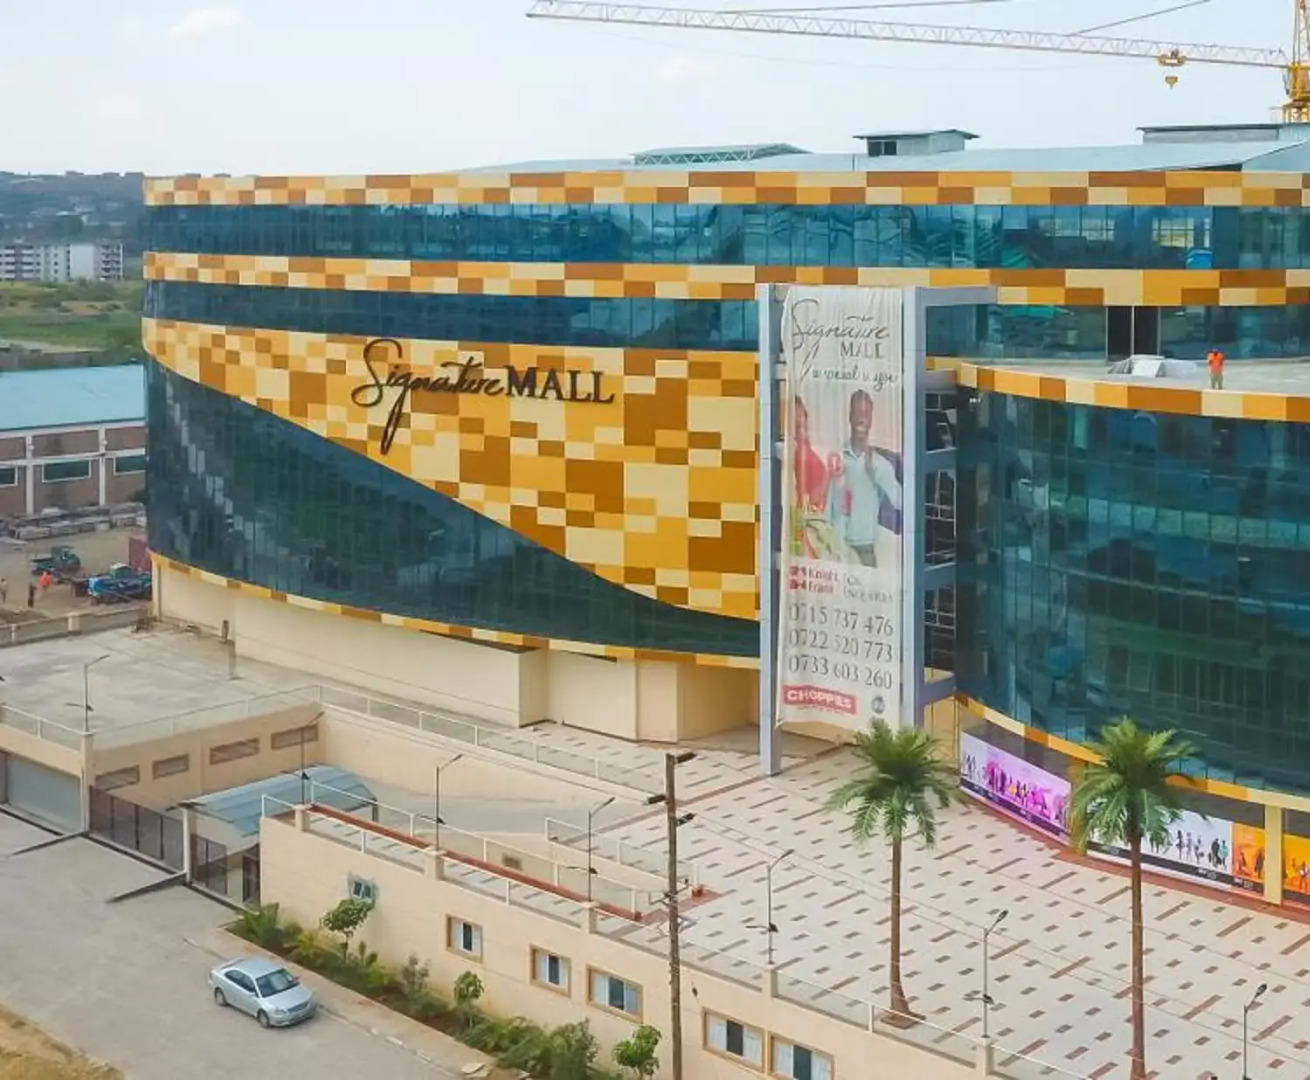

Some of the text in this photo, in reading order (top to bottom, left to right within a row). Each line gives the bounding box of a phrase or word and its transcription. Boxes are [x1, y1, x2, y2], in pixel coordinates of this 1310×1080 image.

[792, 299, 889, 384] Signature
[351, 338, 615, 455] Signature MALL
[788, 602, 894, 637] 0715 737 476
[788, 628, 829, 650] 0722
[864, 641, 893, 663] 773
[788, 653, 829, 675] 0733
[864, 666, 893, 690] 260
